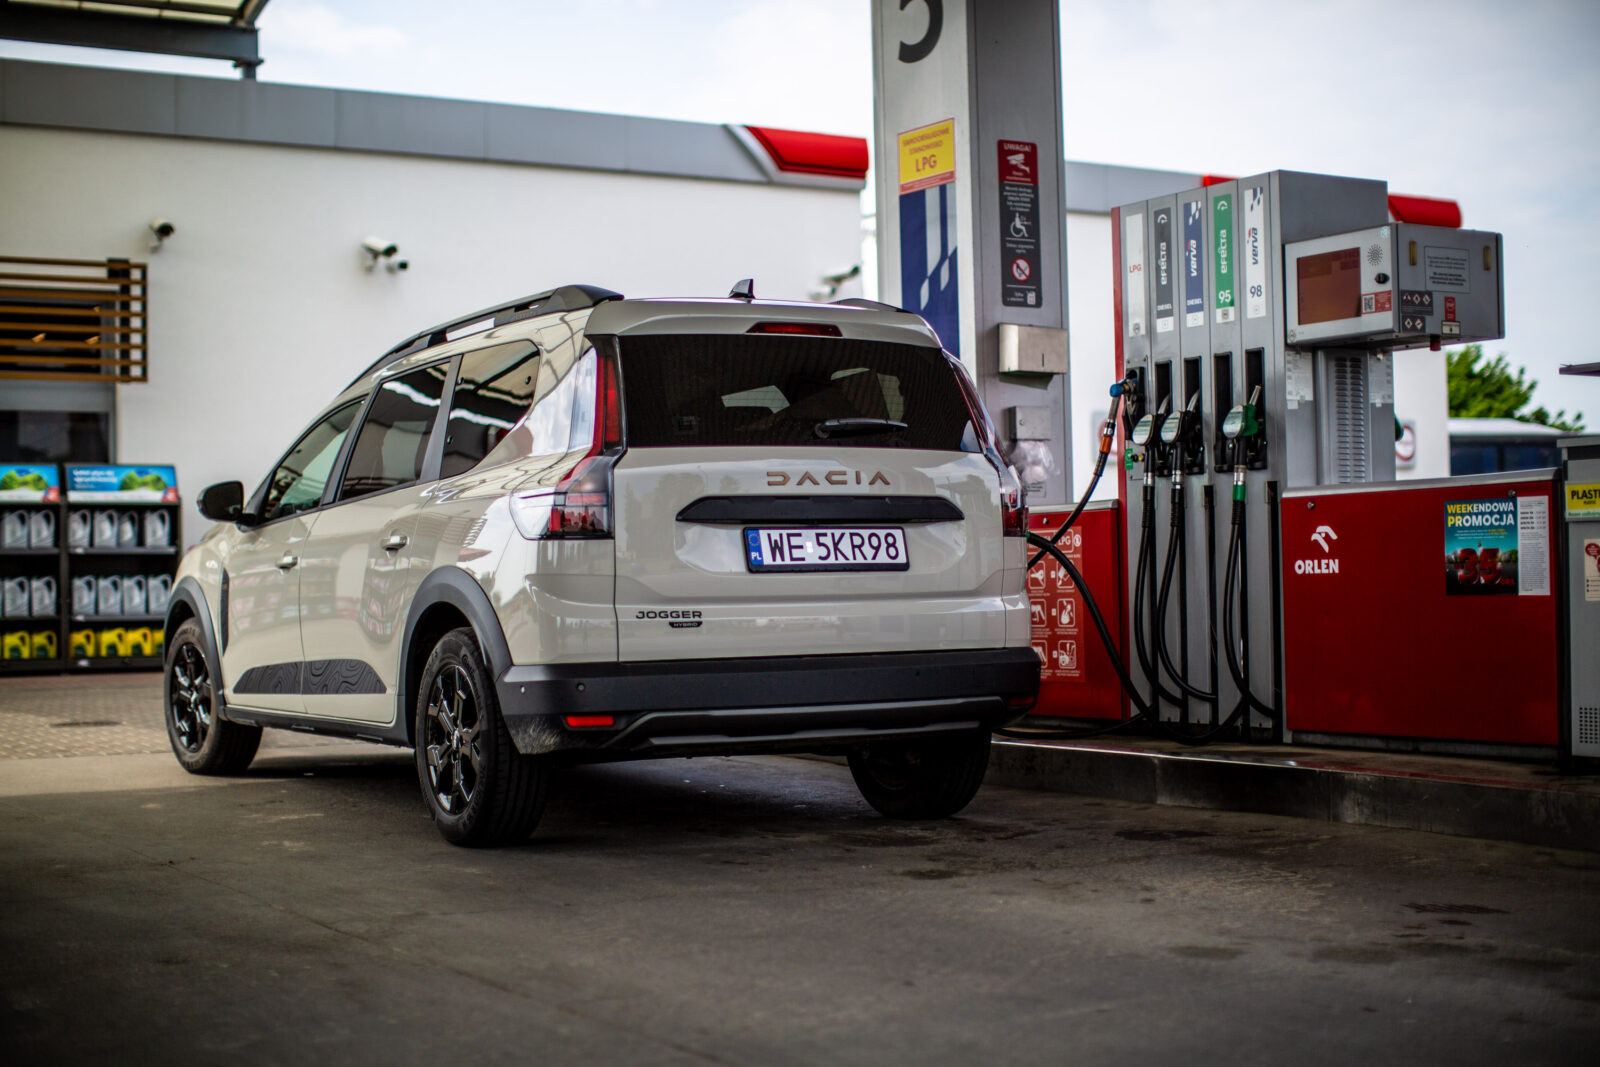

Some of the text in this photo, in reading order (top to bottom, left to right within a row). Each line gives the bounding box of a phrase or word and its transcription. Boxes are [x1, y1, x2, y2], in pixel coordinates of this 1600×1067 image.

[915, 154, 937, 173] LPG
[1129, 264, 1142, 273] LPG
[1218, 290, 1231, 303] 95
[1250, 285, 1262, 298] 98
[767, 470, 891, 486] DACIA
[1447, 502, 1515, 514] WEEKENDOWA
[1448, 514, 1515, 527] PROMOCJA
[1058, 535, 1071, 545] LPG
[767, 532, 899, 562] WE 5KR98
[751, 552, 762, 561] PL
[1294, 559, 1339, 574] ORLEN
[635, 610, 703, 619] JOGGER
